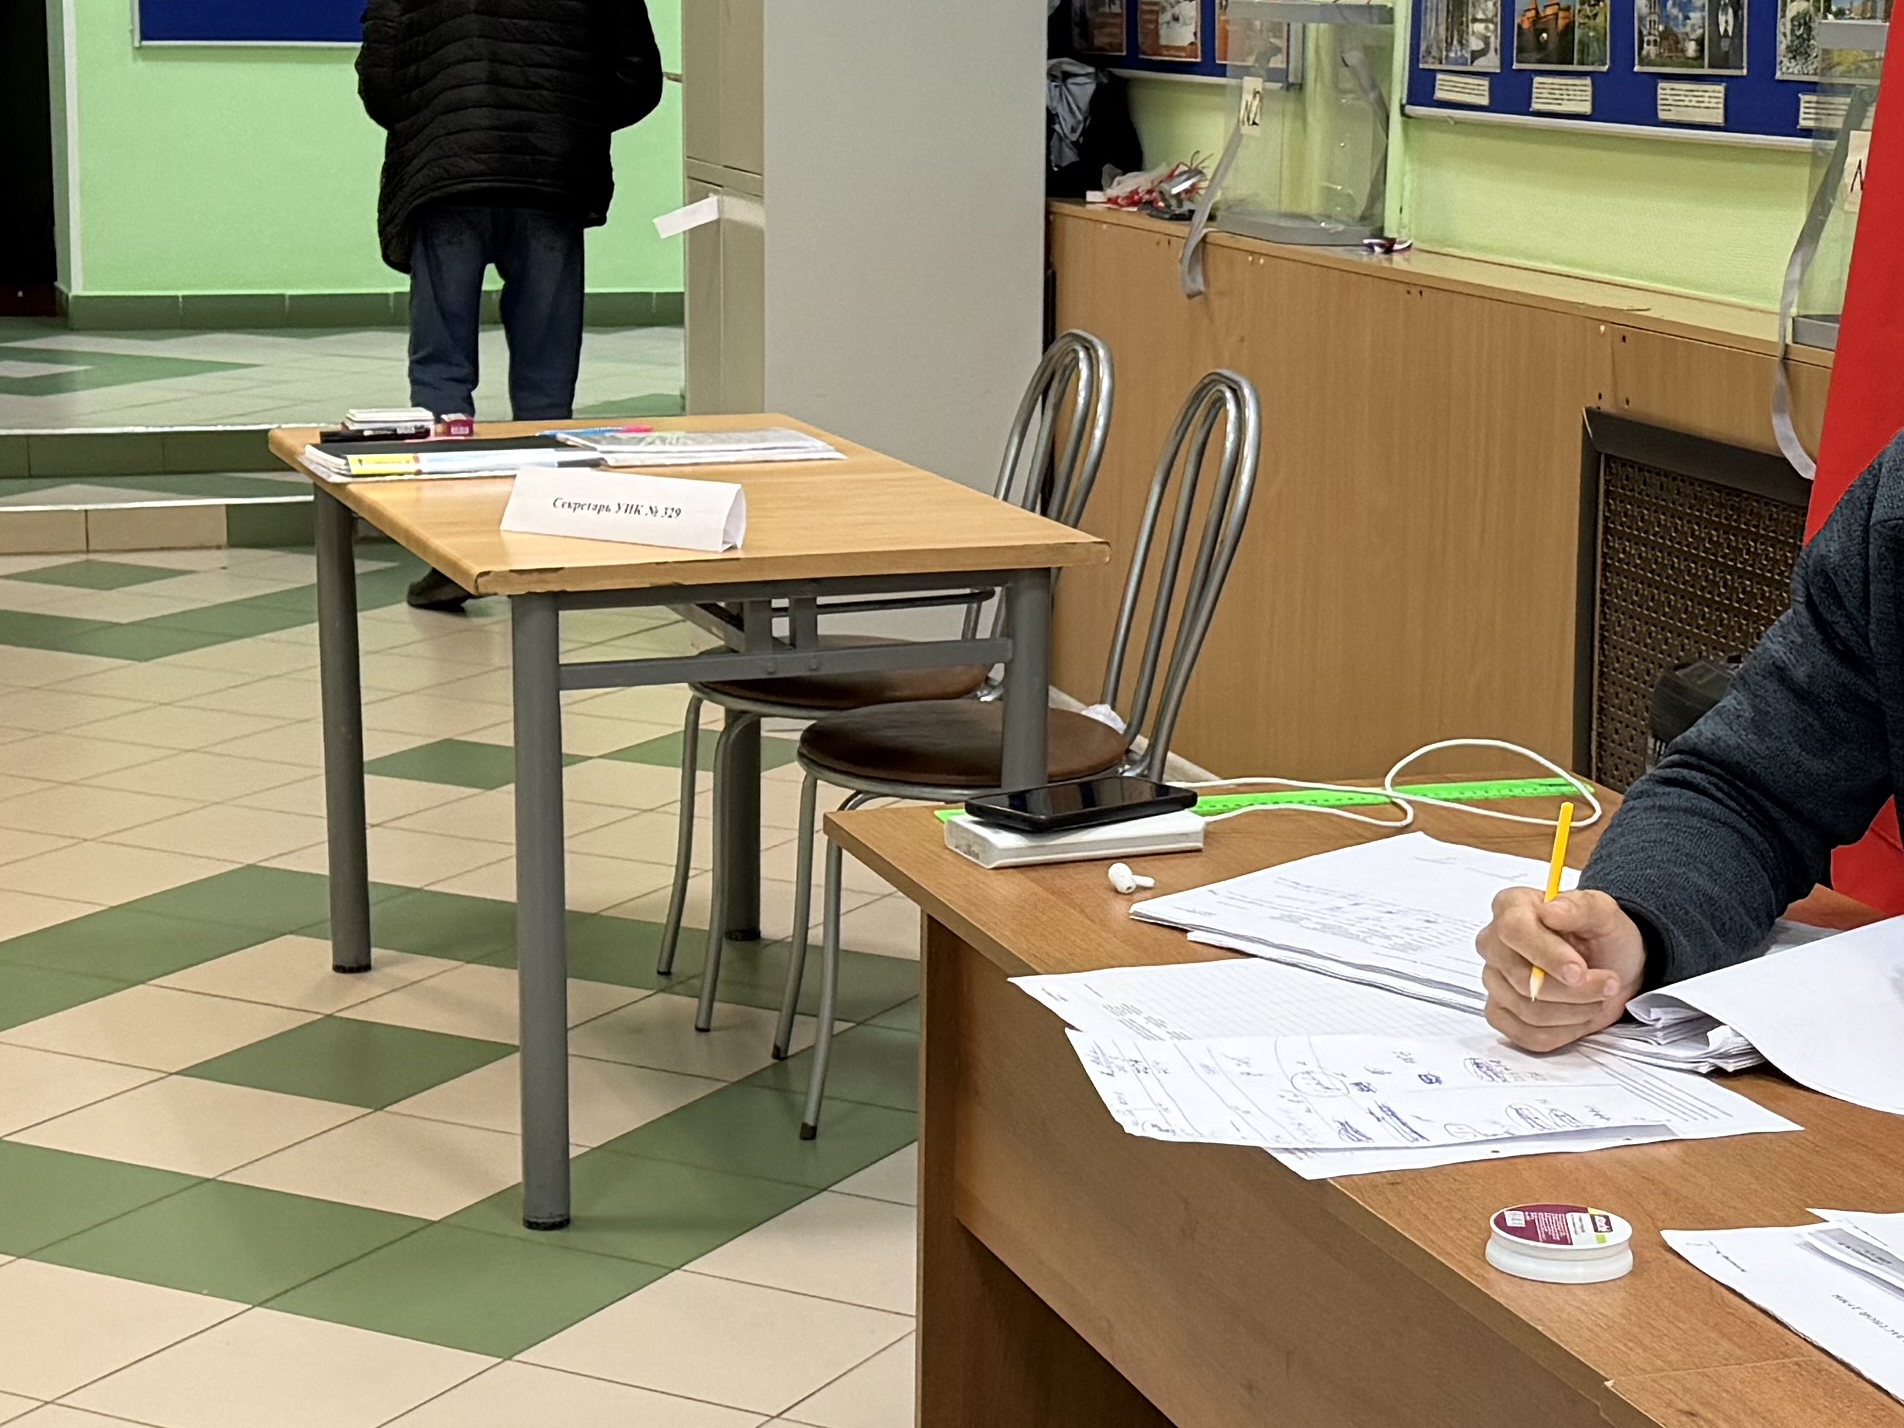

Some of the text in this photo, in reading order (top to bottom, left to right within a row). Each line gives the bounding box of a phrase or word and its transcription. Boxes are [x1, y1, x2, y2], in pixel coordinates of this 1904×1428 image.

[552, 497, 682, 519] Секретарь УИК № 329
